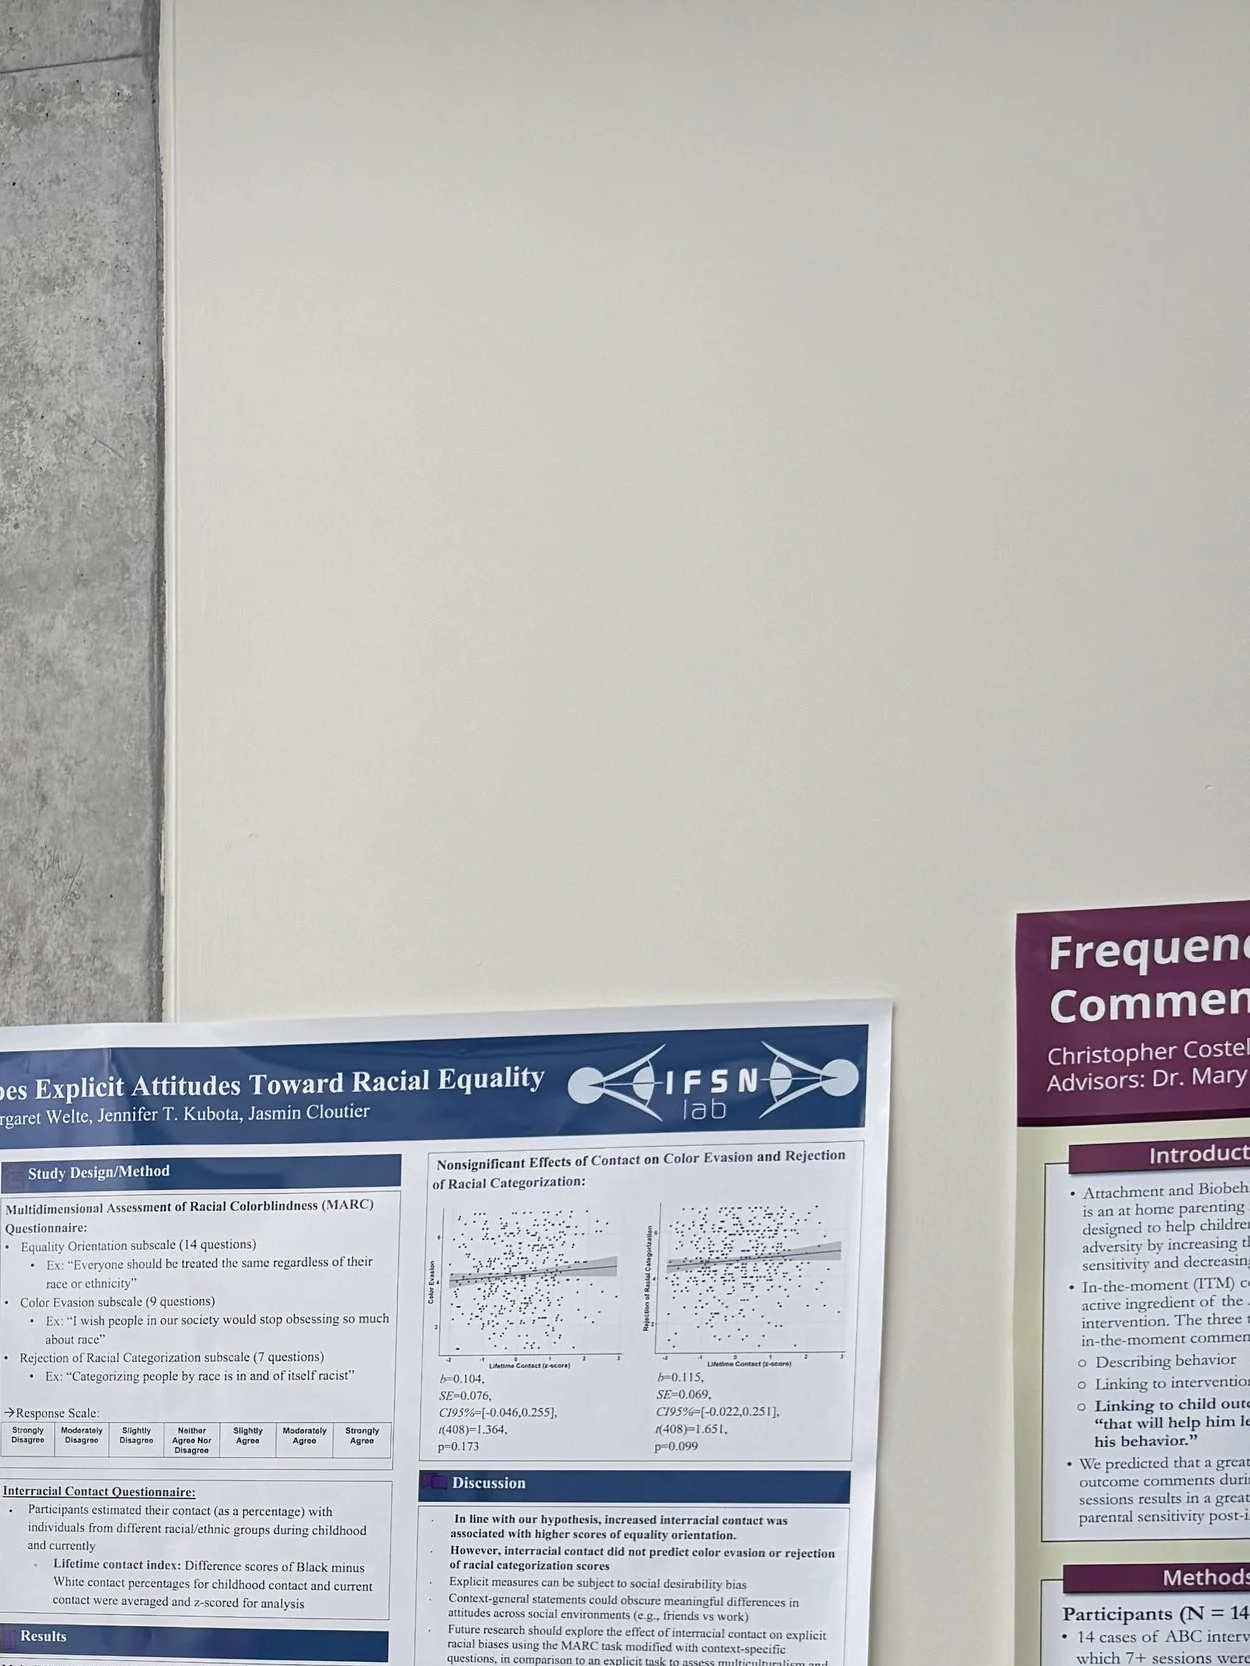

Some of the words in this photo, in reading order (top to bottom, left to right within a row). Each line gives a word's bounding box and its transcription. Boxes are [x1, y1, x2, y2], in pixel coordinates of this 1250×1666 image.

[1048, 1042, 1177, 1066] Christopher
[34, 1075, 124, 1104] Explicit
[131, 1074, 240, 1096] Attitudes
[248, 1072, 344, 1095] Toward
[351, 1069, 429, 1092] Racial
[437, 1065, 545, 1095] Equality
[666, 1067, 758, 1095] IFSN
[1046, 1072, 1145, 1092] Advisors:
[1153, 1069, 1184, 1087] Dr.
[1192, 1067, 1248, 1088] Mary
[45, 1108, 93, 1125] Welte,
[97, 1106, 158, 1123] Jennifer
[162, 1106, 178, 1121] T.
[184, 1105, 243, 1123] Kubota,
[248, 1104, 301, 1120] Jasmin
[306, 1102, 370, 1119] Cloutier
[683, 1097, 726, 1120] lab
[437, 1158, 525, 1172] Nonsignificant
[529, 1156, 571, 1168] Effects
[574, 1155, 589, 1167] of
[590, 1154, 640, 1166] Contact
[643, 1156, 659, 1165] on
[663, 1152, 700, 1164] Color
[703, 1151, 753, 1163] Evasion
[756, 1150, 781, 1162] and
[785, 1149, 845, 1164] Rejection
[28, 1167, 66, 1182] Study
[70, 1164, 170, 1181] Design/Method
[432, 1178, 446, 1190] of
[448, 1178, 486, 1190] Racial
[489, 1175, 585, 1190] Categorization:
[5, 1202, 103, 1215] Multidimensional
[106, 1202, 171, 1213] Assessment
[174, 1201, 187, 1212] of
[189, 1200, 226, 1212] Racial
[229, 1200, 318, 1211] Colorblindness
[321, 1198, 374, 1212] (MARC)
[4, 1222, 87, 1236] Questionnaire:
[21, 1241, 65, 1255] Equality
[67, 1239, 127, 1251] Orientation
[130, 1239, 176, 1250] subscale
[178, 1238, 197, 1252] (14
[200, 1238, 257, 1252] questions)
[1096, 1354, 1172, 1370] Describing
[1175, 1352, 1237, 1366] behavior
[439, 1373, 485, 1384] b=0.104,
[657, 1371, 704, 1383] b=0.115,
[438, 1390, 491, 1402] SE=0.076,
[656, 1389, 712, 1400] SE=0.069,
[16, 1407, 65, 1421] Response
[68, 1407, 99, 1418] Scale:
[12, 1426, 44, 1435] Strongly
[60, 1426, 103, 1436] Moderately
[122, 1426, 151, 1436] Slightly
[177, 1426, 206, 1434] Neither
[233, 1426, 263, 1436] Slightly
[282, 1426, 327, 1436] Moderately
[345, 1426, 380, 1436] Strongly
[438, 1424, 508, 1436] t(408)=1.364,
[655, 1423, 728, 1436] t(408)=1.651,
[11, 1436, 45, 1444] Disagree
[64, 1436, 99, 1445] Disagree
[119, 1436, 154, 1445] Disagree
[171, 1436, 195, 1446] Agree
[197, 1436, 212, 1444] Nor
[235, 1436, 260, 1446] Agree
[292, 1437, 317, 1446] Agree
[349, 1437, 374, 1446] Agree
[174, 1446, 209, 1455] Disagree
[437, 1441, 479, 1454] p=0.173
[654, 1440, 699, 1454] p=0.099
[452, 1476, 526, 1489] Discussion
[2, 1485, 62, 1499] Interracial
[64, 1486, 109, 1499] Contact
[111, 1486, 196, 1499] Questionnaire:
[454, 1513, 466, 1523] In
[469, 1513, 489, 1523] line
[491, 1514, 515, 1524] with
[518, 1516, 538, 1524] our
[541, 1514, 602, 1527] hypothesis,
[604, 1514, 657, 1525] increased
[660, 1514, 719, 1525] interracial
[722, 1516, 764, 1525] contact
[766, 1517, 788, 1525] was
[449, 1576, 489, 1589] Explicit
[491, 1579, 539, 1587] measures
[541, 1579, 560, 1587] can
[562, 1577, 575, 1588] be
[577, 1577, 614, 1590] subject
[617, 1579, 627, 1588] to
[629, 1578, 660, 1588] social
[663, 1578, 723, 1592] desirability
[725, 1579, 747, 1590] bias
[1062, 1606, 1173, 1626] Participants
[1179, 1605, 1204, 1625] (N
[21, 1629, 67, 1642] Results
